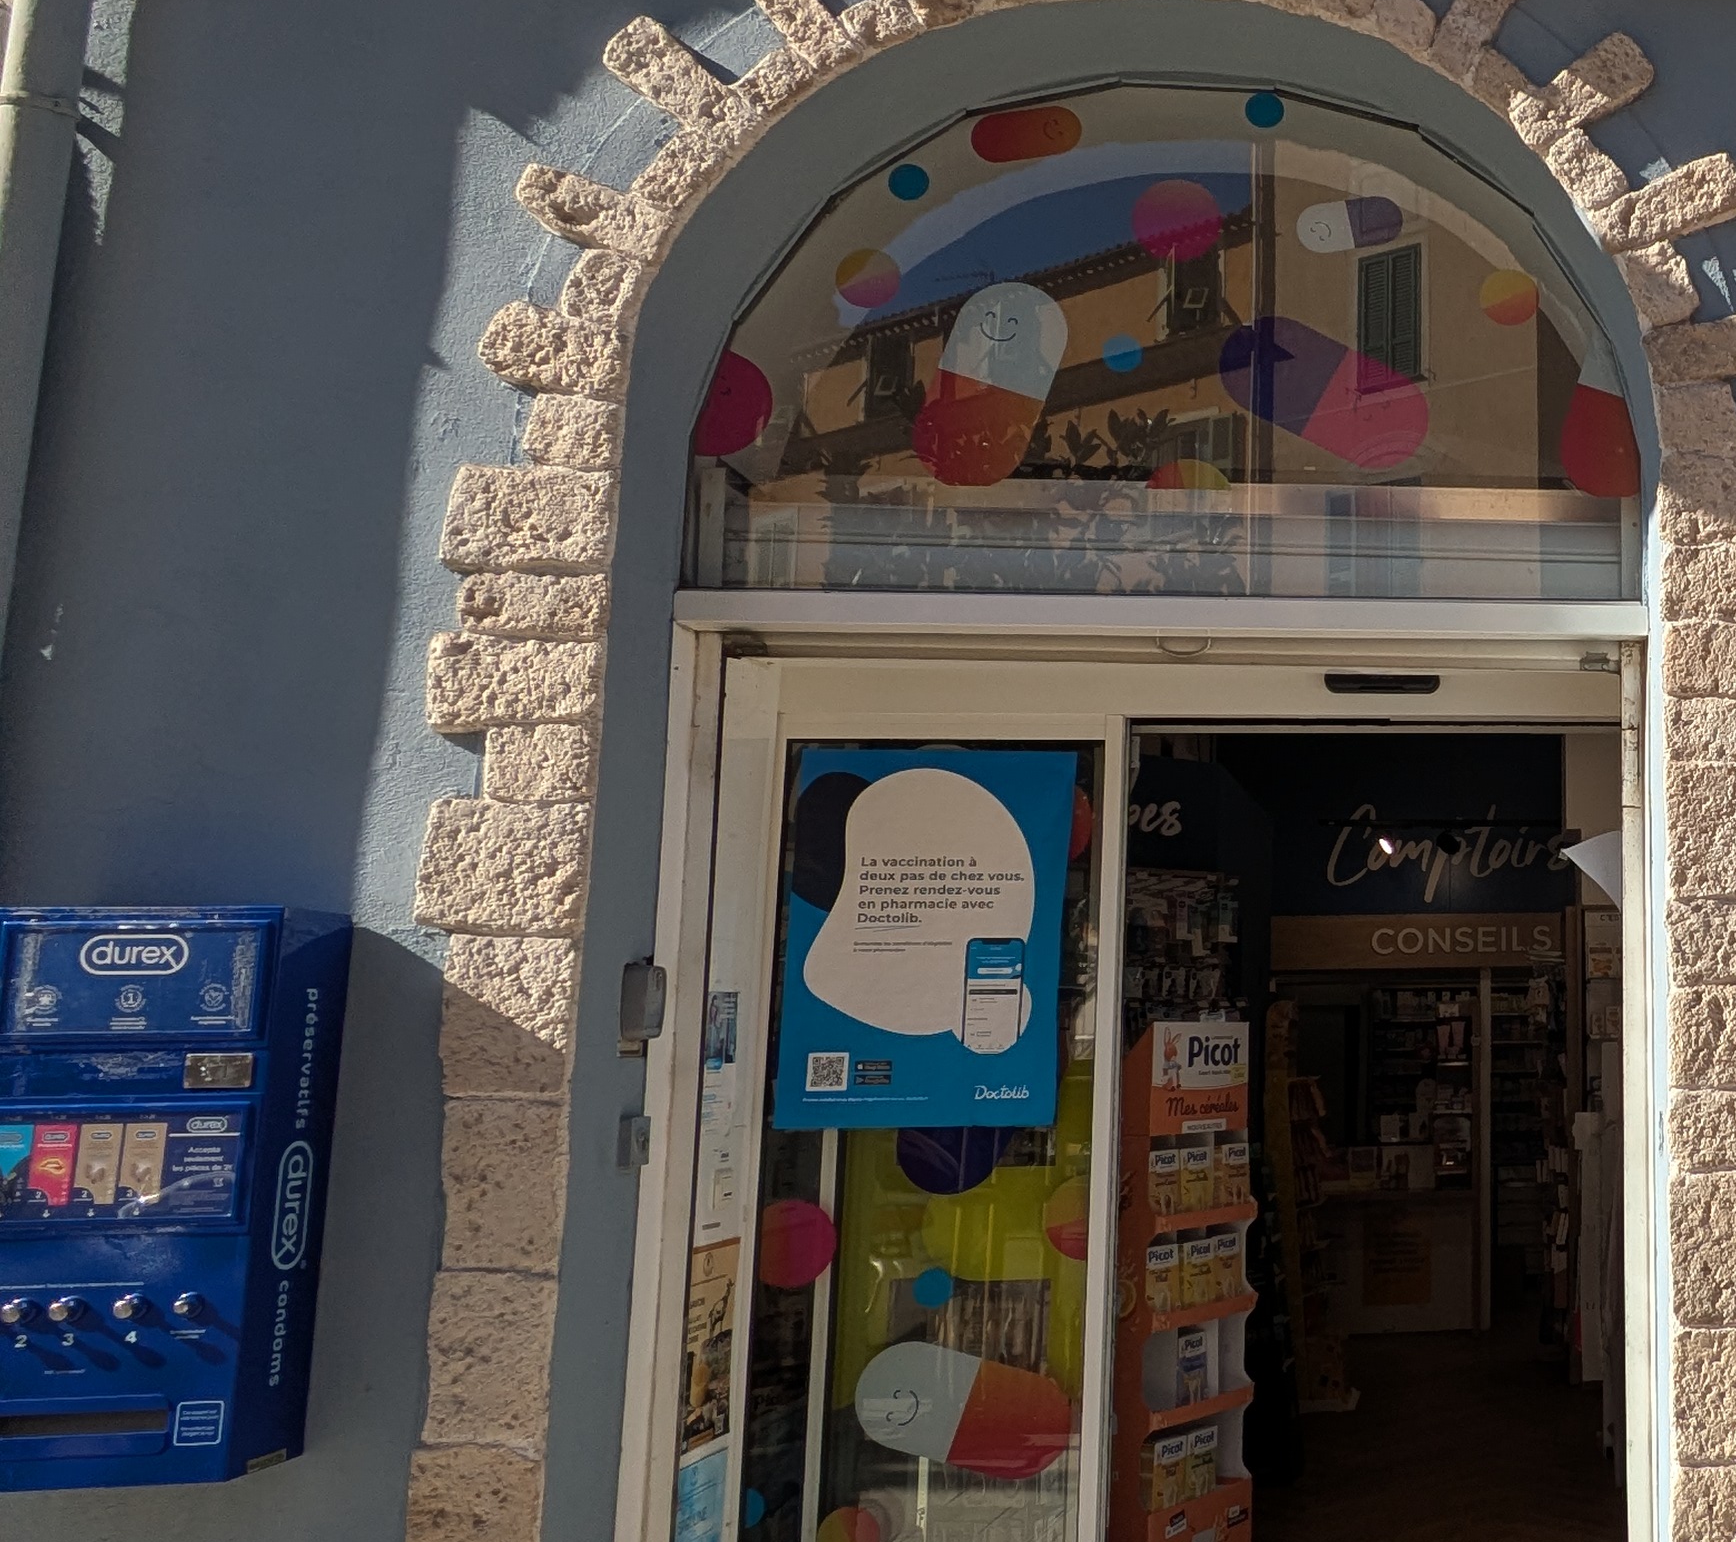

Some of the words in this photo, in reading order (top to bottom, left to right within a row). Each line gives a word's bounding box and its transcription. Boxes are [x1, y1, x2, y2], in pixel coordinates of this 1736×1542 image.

[860, 857, 878, 868] La
[881, 856, 965, 868] vaccination
[968, 856, 977, 868] à
[859, 870, 896, 882] deux
[899, 871, 925, 884] pas
[928, 870, 946, 882] de
[950, 870, 985, 882] chez
[988, 872, 1025, 882] vous.
[859, 884, 909, 896] Prenez
[913, 884, 1001, 896] rendez-vous
[858, 900, 876, 910] en
[880, 898, 958, 912] pharmacie
[961, 900, 994, 910] avec
[857, 912, 923, 925] Doctolib.
[1371, 925, 1554, 956] CONSEILS
[91, 940, 178, 970] durex
[1188, 1035, 1242, 1068] Picot
[973, 1084, 1030, 1101] Doctolib
[1166, 1096, 1198, 1117] Mes
[283, 1159, 309, 1259] durex
[14, 1334, 28, 1348] 2
[61, 1333, 75, 1347] 3
[124, 1330, 138, 1344] 4
[268, 1279, 290, 1389] condoms
